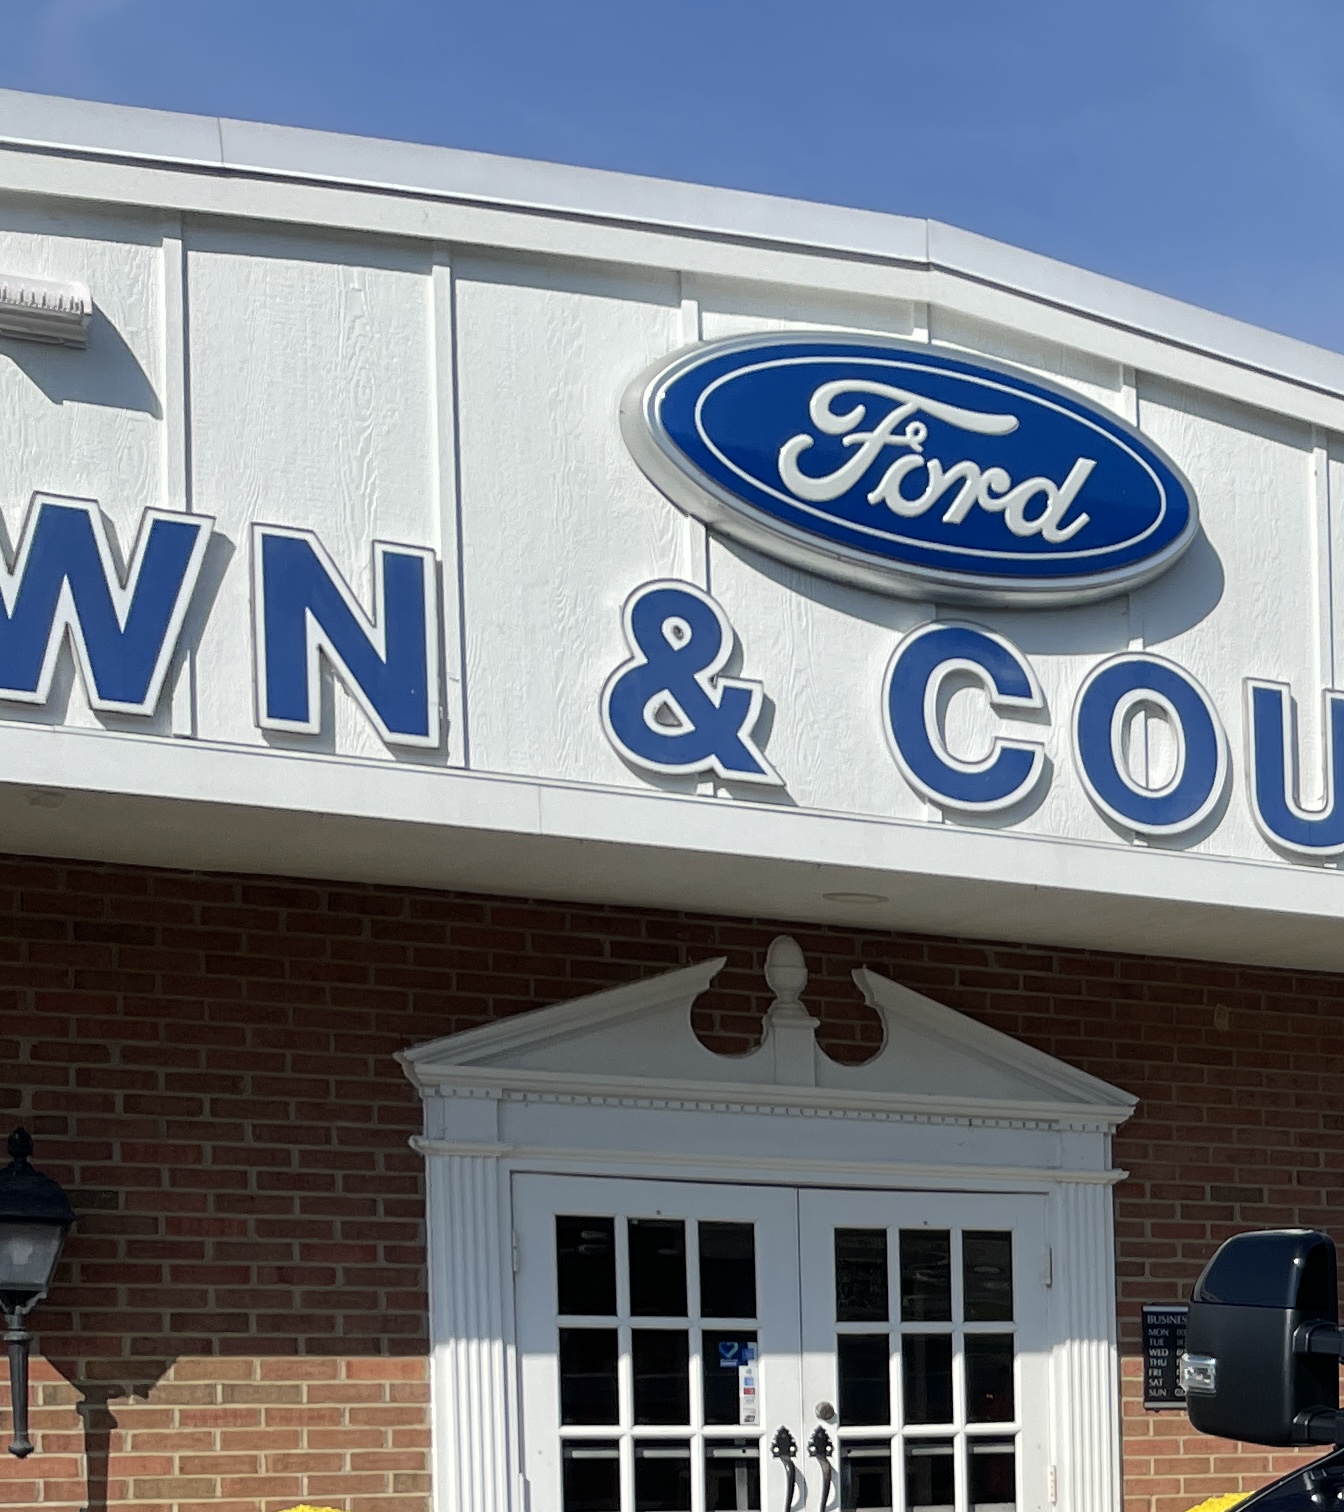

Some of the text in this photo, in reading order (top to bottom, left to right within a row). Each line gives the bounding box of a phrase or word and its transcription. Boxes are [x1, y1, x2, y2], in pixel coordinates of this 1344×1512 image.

[778, 379, 1097, 544] Ford
[600, 578, 786, 786] &
[1147, 1314, 1188, 1325] BUSINES
[1148, 1328, 1170, 1337] MON
[1149, 1338, 1164, 1347] TUE
[1149, 1348, 1169, 1357] WED
[1149, 1358, 1168, 1367] THU
[1149, 1368, 1162, 1377] FRI
[1149, 1378, 1163, 1387] SAT
[1149, 1388, 1167, 1397] SUN
